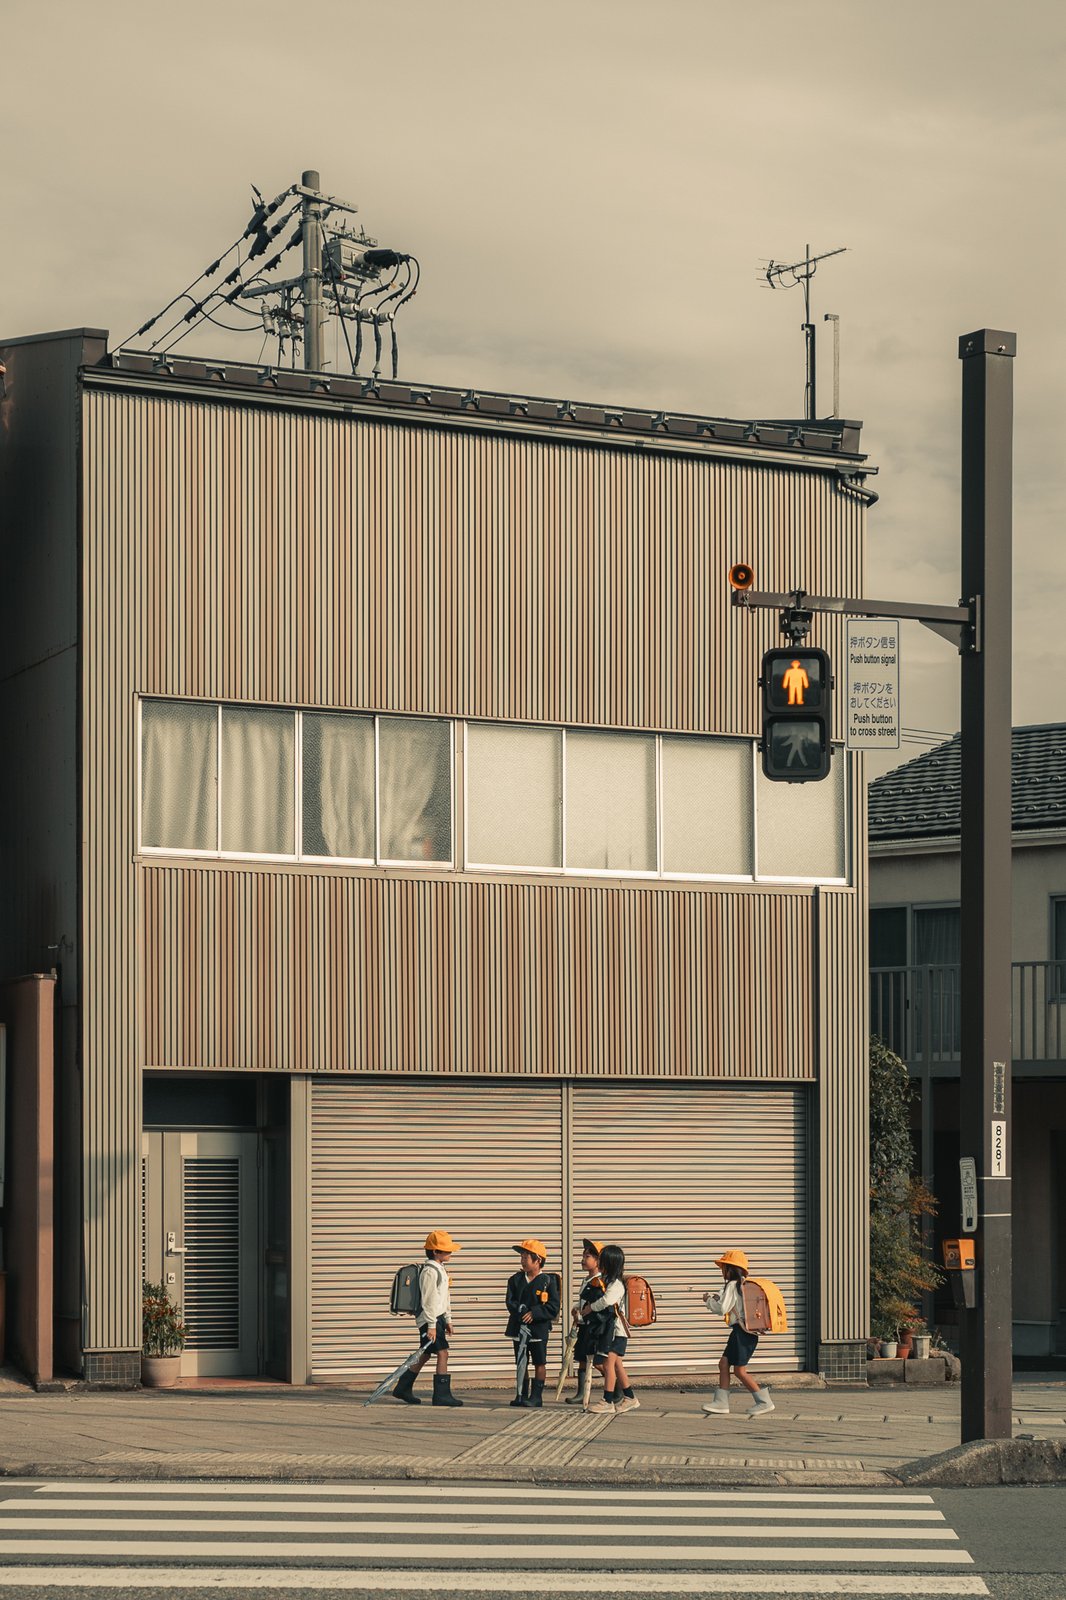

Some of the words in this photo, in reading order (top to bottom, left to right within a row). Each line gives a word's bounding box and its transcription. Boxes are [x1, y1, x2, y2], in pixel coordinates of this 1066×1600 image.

[850, 636, 896, 649] 押ボタン信号
[850, 653, 863, 664] Push
[864, 653, 880, 664] button
[881, 653, 896, 667] signal
[853, 682, 893, 695] 押ボタンを
[850, 697, 897, 709] おしてください
[853, 713, 870, 724] Push
[871, 713, 893, 724] button
[850, 726, 857, 736] to
[858, 727, 876, 736] cross
[877, 726, 897, 736] street
